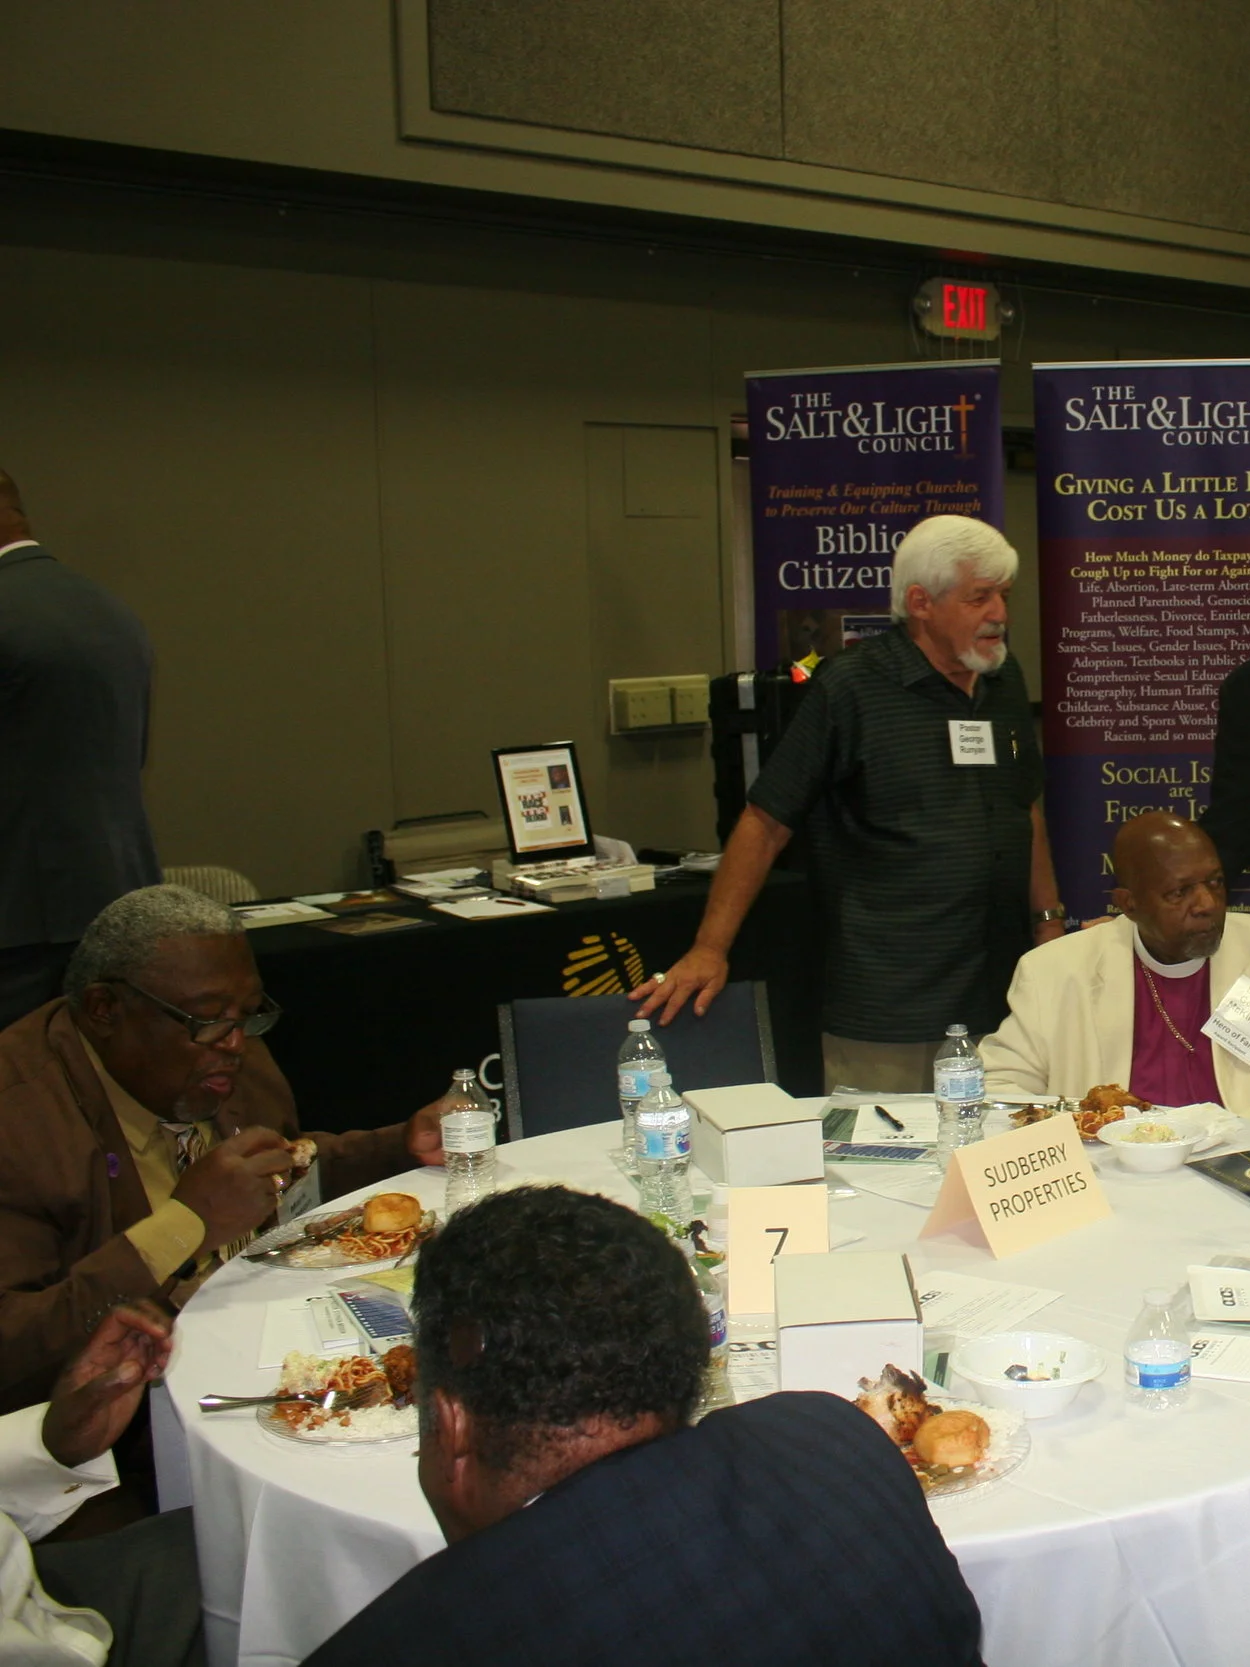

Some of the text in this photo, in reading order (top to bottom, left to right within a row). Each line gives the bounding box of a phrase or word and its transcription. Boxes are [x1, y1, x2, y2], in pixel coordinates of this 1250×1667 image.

[943, 284, 988, 330] EXIT
[791, 392, 832, 408] THE
[1092, 386, 1136, 400] THE
[858, 435, 955, 454] COUNCIL
[768, 480, 979, 500] Training & Equipping Churches
[765, 498, 981, 517] to Preserve Our Culture Through
[1085, 551, 1112, 562] How
[1115, 551, 1149, 562] Much
[1152, 550, 1192, 564] Money
[1195, 549, 1210, 561] do
[1070, 566, 1109, 581] Cough
[1112, 566, 1130, 580] Up
[1134, 568, 1145, 577] to
[1149, 565, 1179, 580] Fight
[1183, 565, 1204, 577] For
[1205, 567, 1218, 576] or
[1079, 582, 1103, 593] Life,
[1106, 581, 1159, 593] Abortion,
[1162, 581, 1214, 592] Late-term
[1092, 596, 1136, 608] Planned
[1139, 595, 1204, 607] Parenthood,
[1081, 611, 1158, 623] Fatherlessness,
[1161, 610, 1207, 622] Divorce,
[1062, 627, 1115, 641] Programs,
[1118, 625, 1162, 637] Welfare,
[1166, 624, 1193, 636] Food
[1196, 624, 1239, 639] Stamps,
[1057, 641, 1109, 653] Same-Sex
[1112, 641, 1146, 653] Issues,
[1149, 639, 1191, 652] Gender
[1193, 639, 1226, 651] Issues,
[1072, 656, 1127, 671] Adoption,
[1129, 655, 1185, 667] Textbooks
[1188, 655, 1199, 666] in
[1202, 654, 1236, 666] Public
[1067, 671, 1151, 686] Comprehensive
[1154, 669, 1188, 681] Sexual
[1066, 685, 1137, 700] Pornography,
[1140, 685, 1181, 696] Human
[1057, 700, 1112, 713] Childcare,
[1115, 700, 1169, 712] Substance
[1171, 699, 1208, 711] Abuse,
[1066, 716, 1116, 730] Celebrity
[1119, 715, 1139, 727] and
[1142, 714, 1176, 730] Sports
[1104, 730, 1146, 742] Racism,
[1149, 729, 1169, 741] and
[1173, 733, 1185, 741] so
[1169, 786, 1193, 798] are
[1212, 1018, 1231, 1035] Hero
[1231, 1029, 1242, 1040] of
[984, 1143, 1067, 1188] SUDBERRY
[989, 1171, 1088, 1222] PROPERTIES
[765, 1227, 789, 1264] 7
